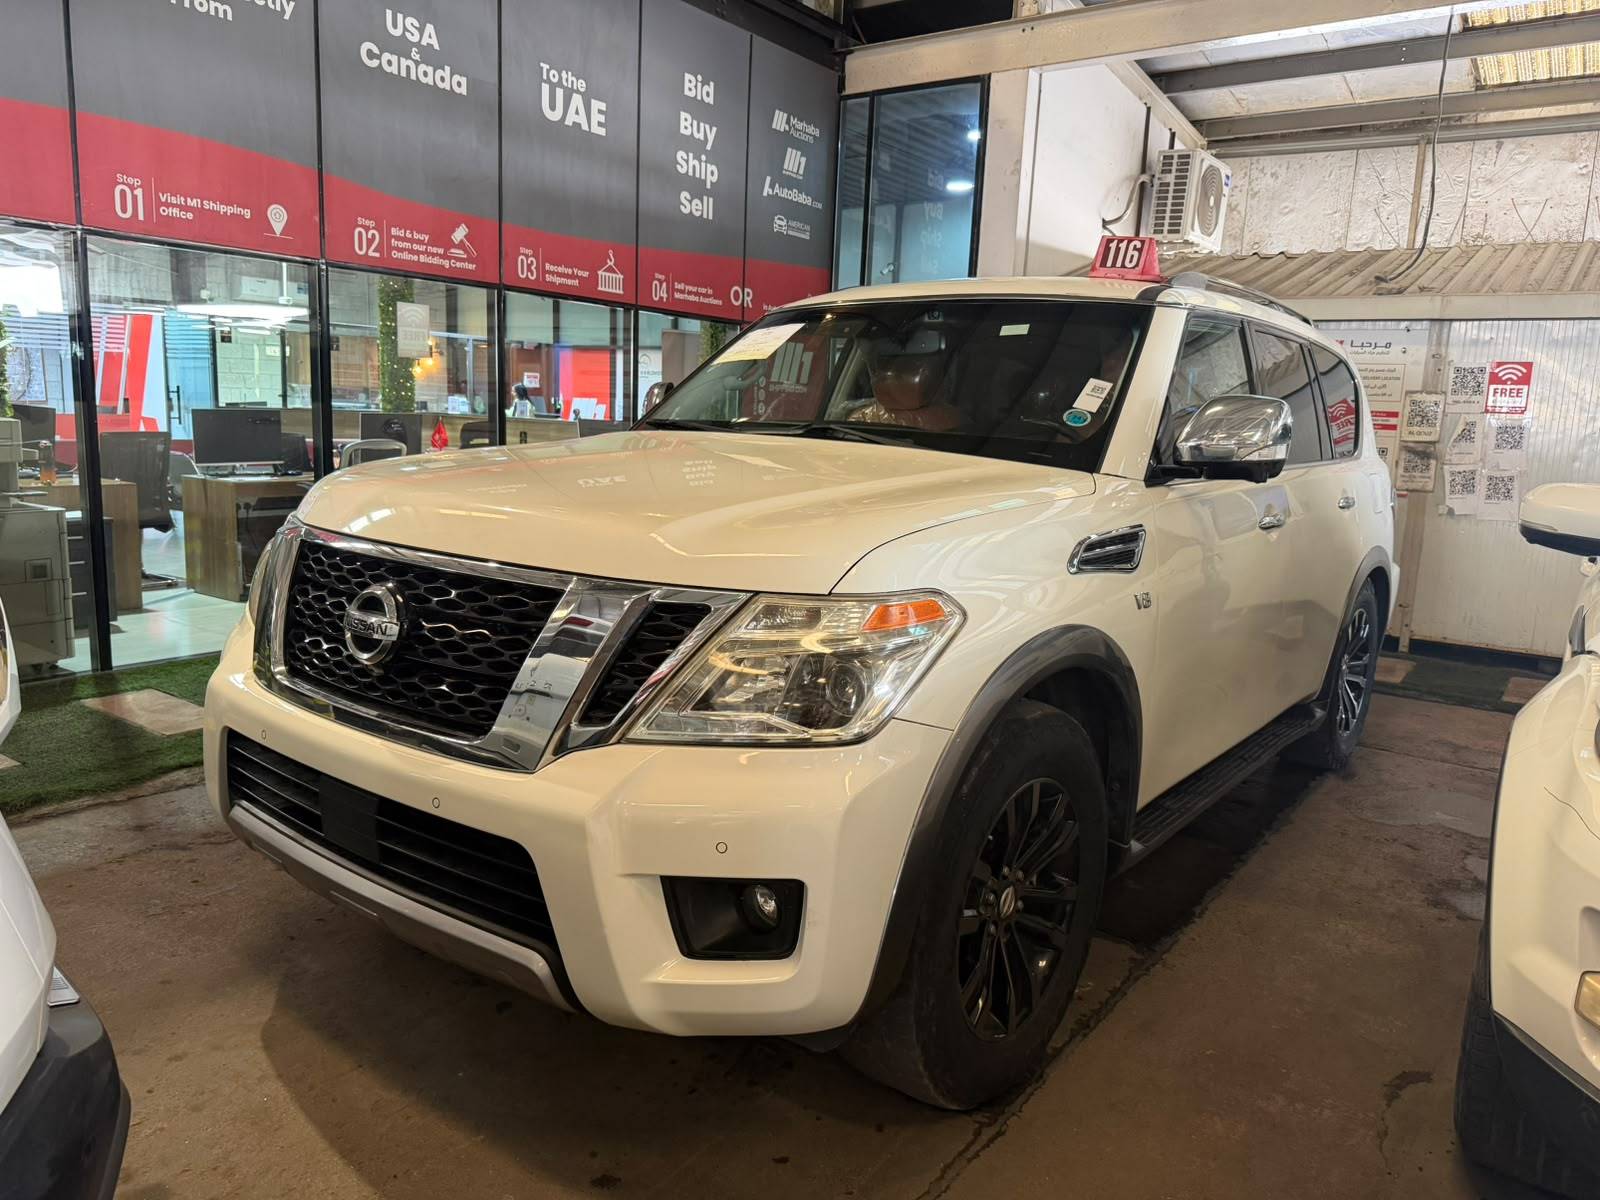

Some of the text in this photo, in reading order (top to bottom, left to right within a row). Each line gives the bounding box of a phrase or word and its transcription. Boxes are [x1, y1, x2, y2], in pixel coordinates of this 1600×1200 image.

[386, 8, 440, 51] USA
[410, 47, 421, 61] &
[360, 41, 467, 96] Canada
[540, 62, 587, 92] To the
[684, 72, 715, 105] Bid
[541, 82, 607, 136] UAE
[679, 111, 717, 150] Buy
[790, 114, 820, 137] Marhaba
[116, 173, 142, 188] Step
[675, 150, 719, 189] Ship
[114, 183, 145, 221] 01
[158, 192, 252, 219] Visit M1 Shipping
[159, 206, 194, 220] Office
[679, 190, 713, 220] Sell
[357, 216, 376, 229] Step
[354, 226, 381, 258] 02
[391, 227, 430, 243] Bid & buy
[391, 238, 445, 255] from our new
[391, 250, 477, 271] Online Bidding Center
[1105, 239, 1142, 268] 116
[517, 254, 537, 280] 03
[545, 262, 590, 278] Receive Your
[545, 273, 579, 287] Shipment
[652, 280, 668, 302] 04
[730, 285, 753, 308] OR
[1492, 387, 1524, 398] FREE
[1134, 591, 1152, 610] V8
